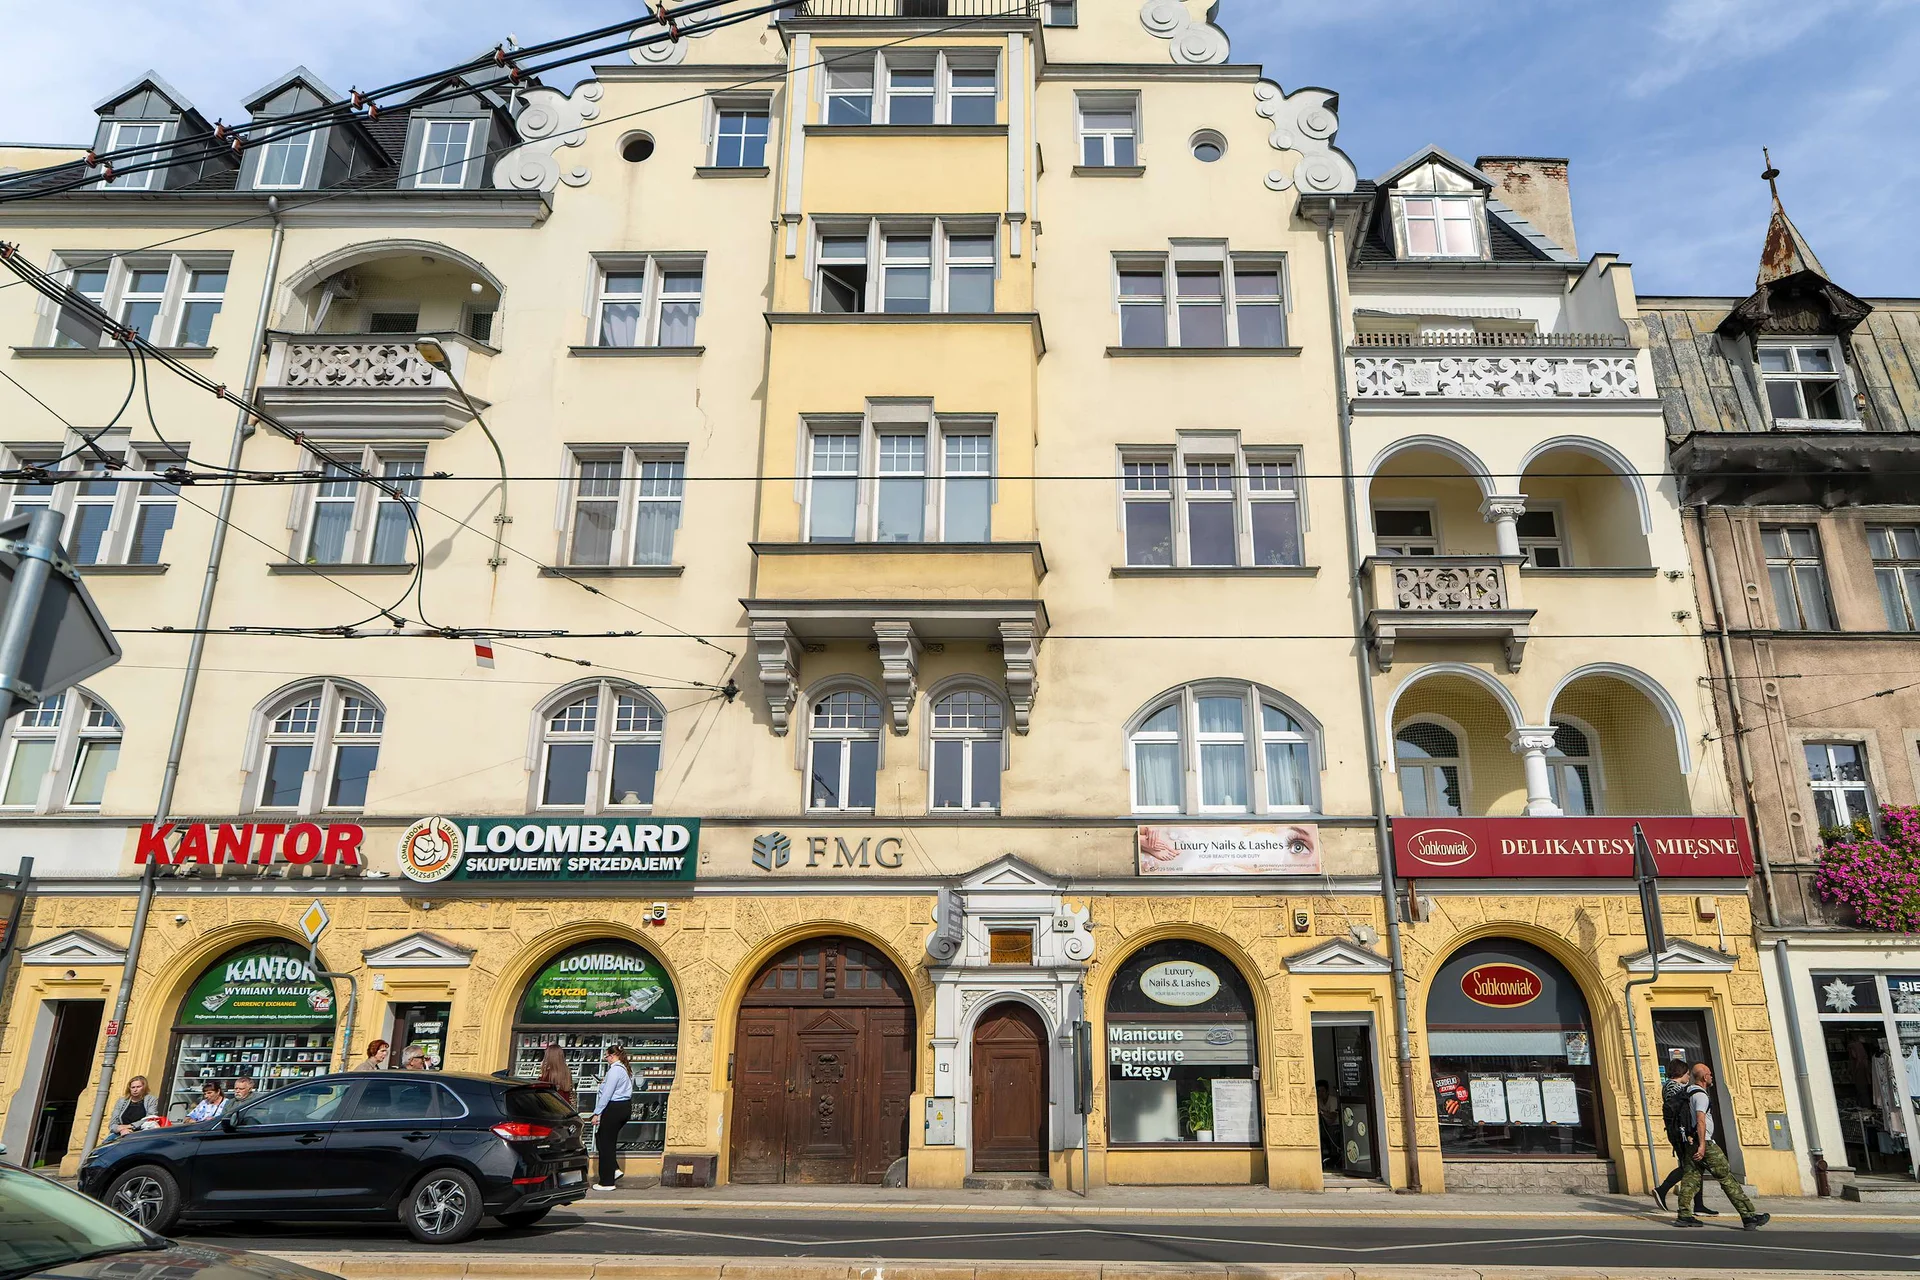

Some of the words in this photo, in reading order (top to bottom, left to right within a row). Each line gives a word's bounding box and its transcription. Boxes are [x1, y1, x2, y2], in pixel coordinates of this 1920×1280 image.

[134, 822, 367, 865] KANTOR
[464, 825, 691, 853] LOOMBARD
[1174, 840, 1209, 853] Luxury
[1211, 840, 1237, 850] Nails
[1238, 841, 1248, 850] &
[1249, 840, 1284, 850] Lashes
[1417, 835, 1469, 855] Sobkowiak
[805, 836, 904, 869] FMG
[1501, 839, 1635, 855] DELIKATESY
[1655, 838, 1739, 859] MIĘSNE
[406, 862, 451, 879] NAJLEPSZYCH
[465, 857, 562, 873] SKUPUJEMY
[567, 857, 685, 872] SPRZEDAJEMY
[1058, 920, 1068, 928] 49
[225, 957, 317, 982] KANTOR
[560, 954, 646, 973] LOOMBARD
[1164, 967, 1195, 977] Luxury
[1149, 978, 1170, 987] Nails
[1171, 979, 1179, 987] &
[1181, 978, 1211, 987] Lashes
[1473, 971, 1534, 996] Sobkowiak
[224, 987, 275, 996] WYMIANY
[277, 987, 312, 995] WALUT
[542, 987, 587, 996] POŻYCZKI
[1109, 1027, 1184, 1041] Manicure
[1206, 1031, 1234, 1041] OPEN
[1110, 1047, 1185, 1062] Pedicure
[1121, 1063, 1172, 1080] Rzęsy
[1435, 1077, 1458, 1088] SERDELKI
